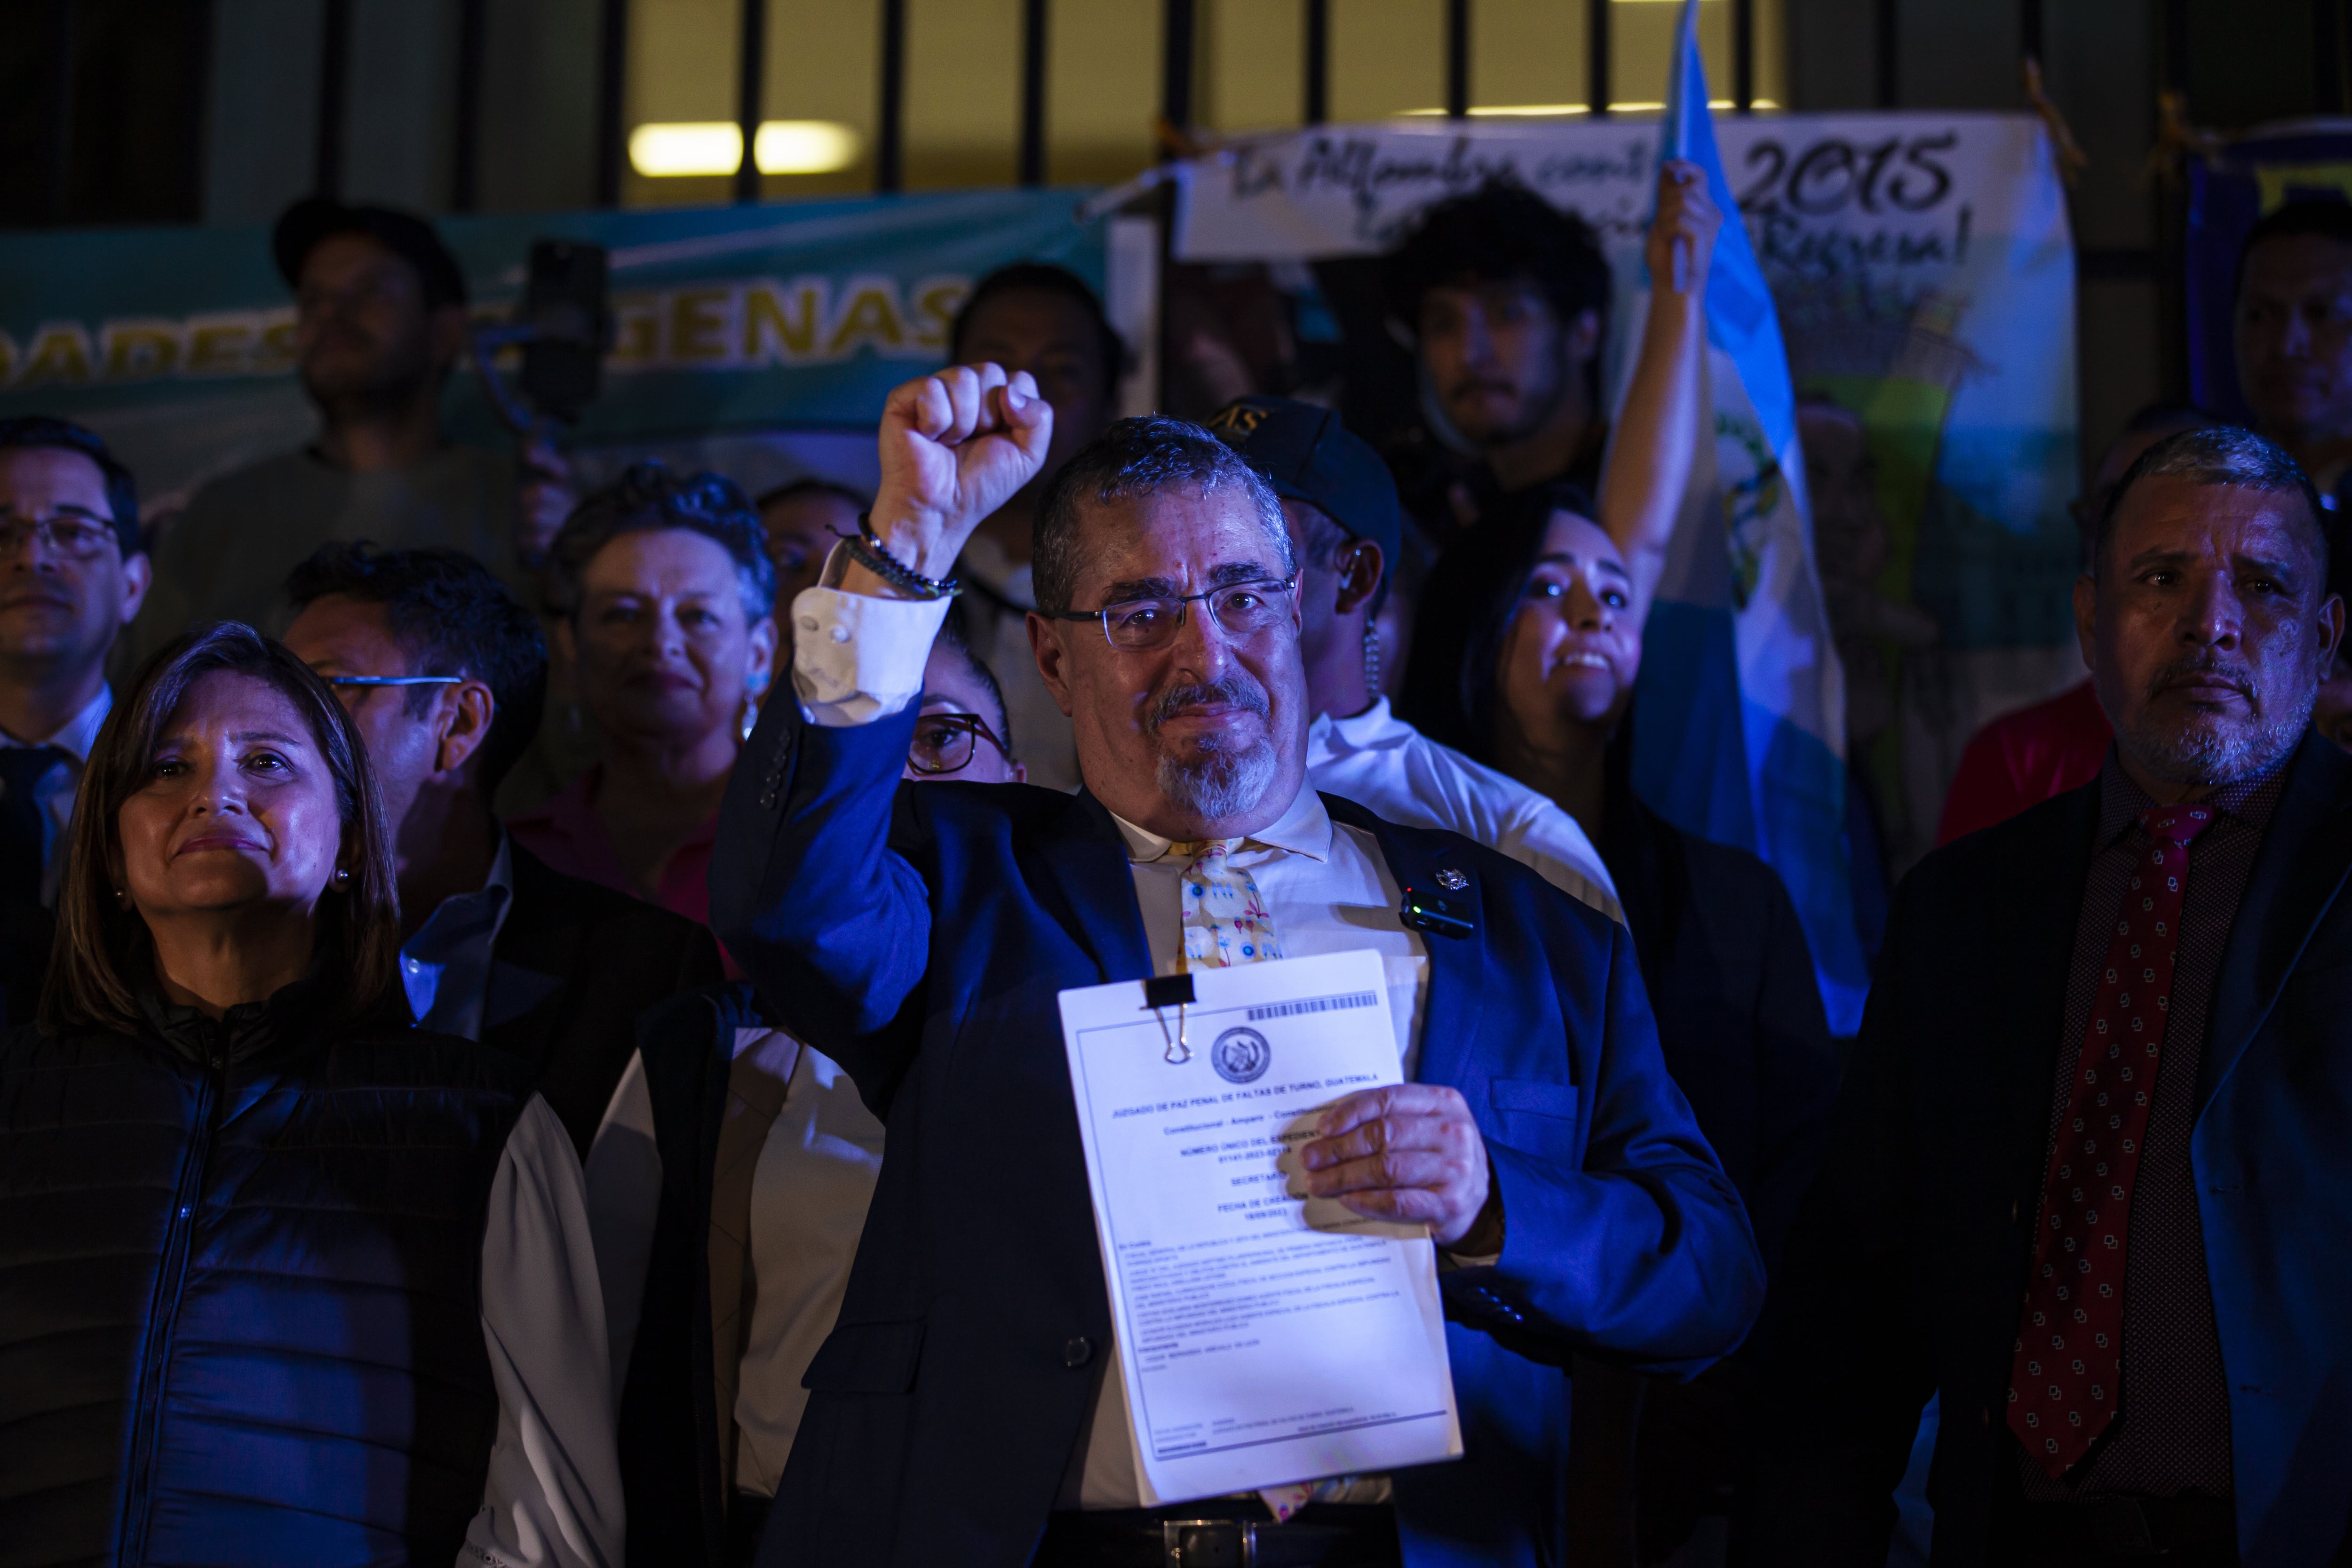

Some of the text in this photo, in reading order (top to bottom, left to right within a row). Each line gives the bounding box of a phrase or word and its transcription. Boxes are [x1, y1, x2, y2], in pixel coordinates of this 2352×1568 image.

[1740, 132, 1957, 215] 2015
[1156, 1101, 1168, 1113] DE
[1170, 1098, 1188, 1109] PAZ
[1190, 1095, 1220, 1106] PENAL
[1221, 1091, 1234, 1103] DE
[1236, 1088, 1271, 1099] FALTAS
[1273, 1084, 1286, 1095] DE
[1324, 1072, 1378, 1088] GUATEMALA
[1217, 1201, 1247, 1213] FECHA
[1248, 1198, 1261, 1209] DE
